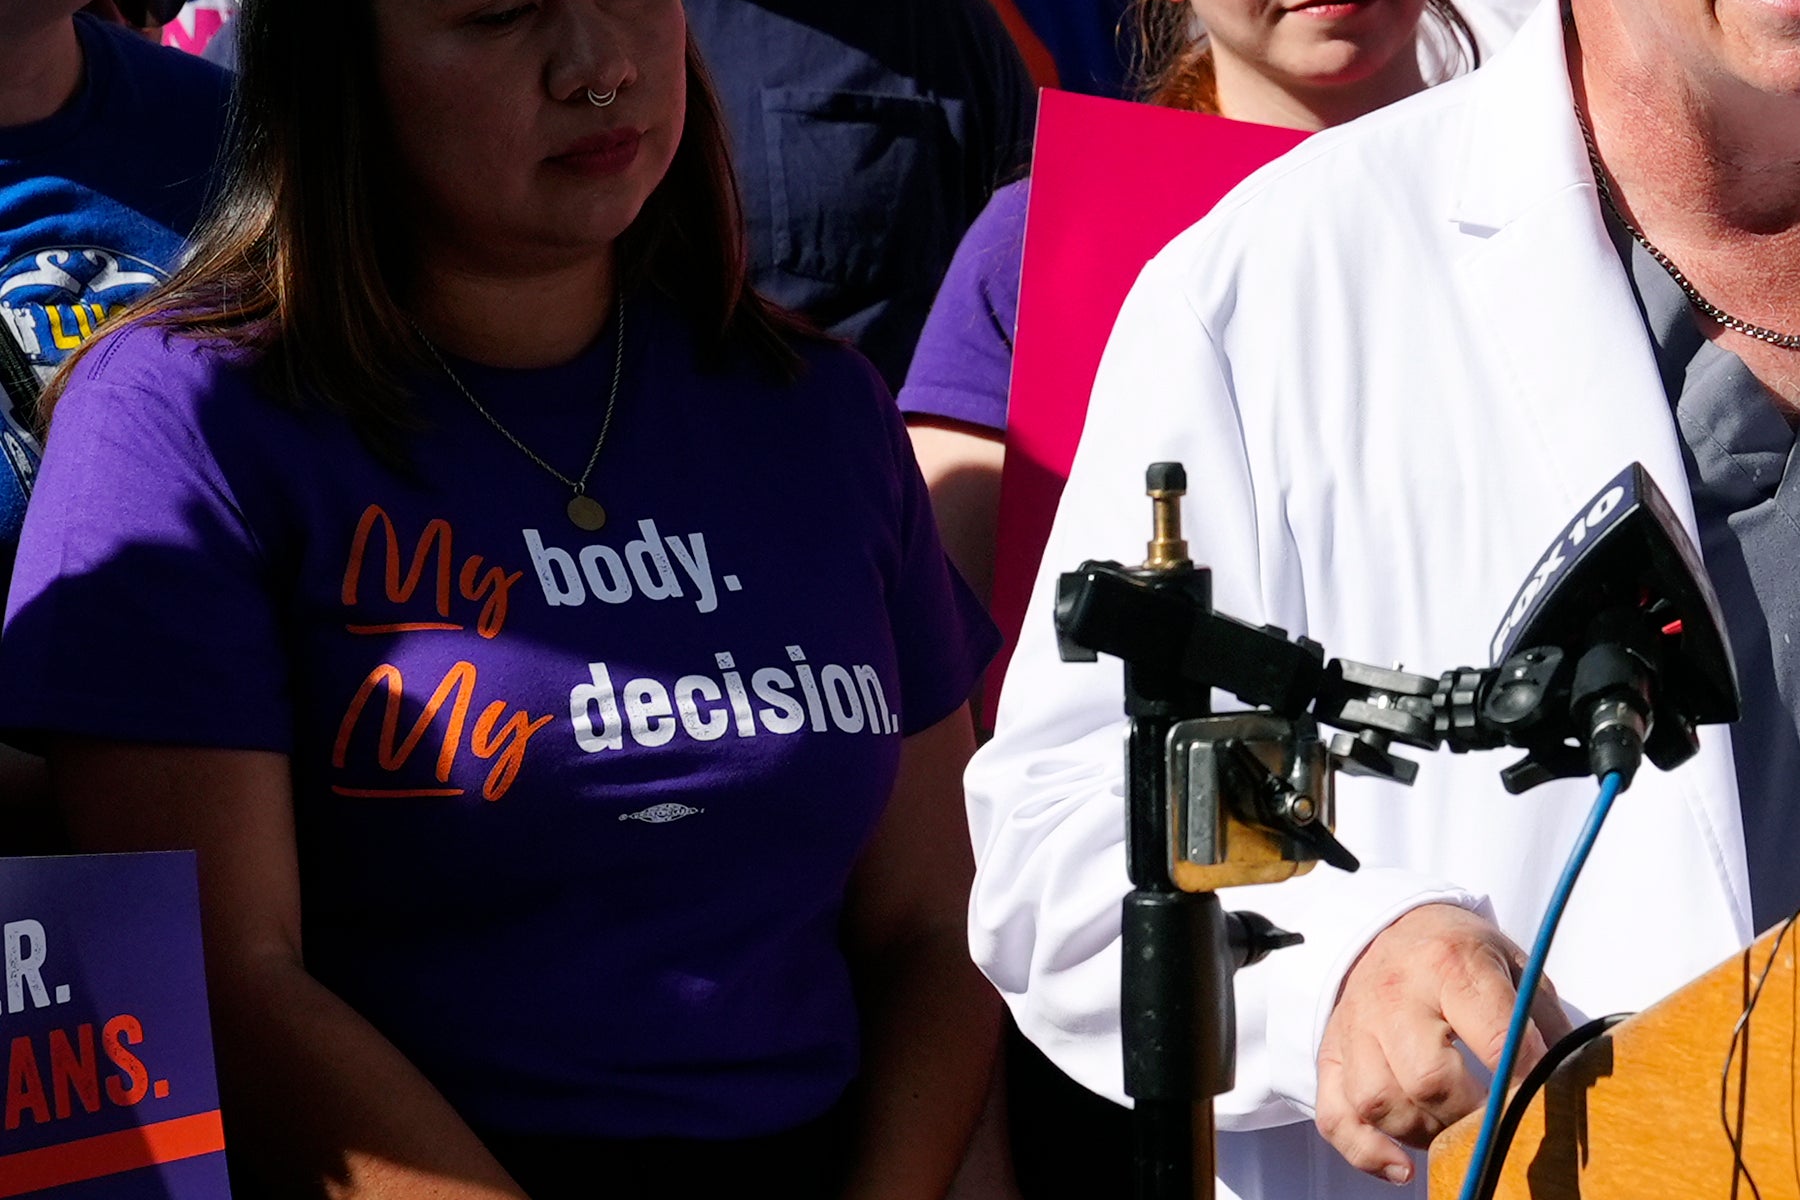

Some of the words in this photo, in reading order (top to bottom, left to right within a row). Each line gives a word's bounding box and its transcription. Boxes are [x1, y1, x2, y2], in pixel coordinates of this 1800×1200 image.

[341, 503, 523, 640] My
[522, 518, 743, 614] body.
[1492, 540, 1566, 666] FOX
[1568, 486, 1626, 547] 10
[330, 660, 554, 801] My
[568, 644, 899, 753] decision.
[4, 1013, 170, 1130] ANS.
